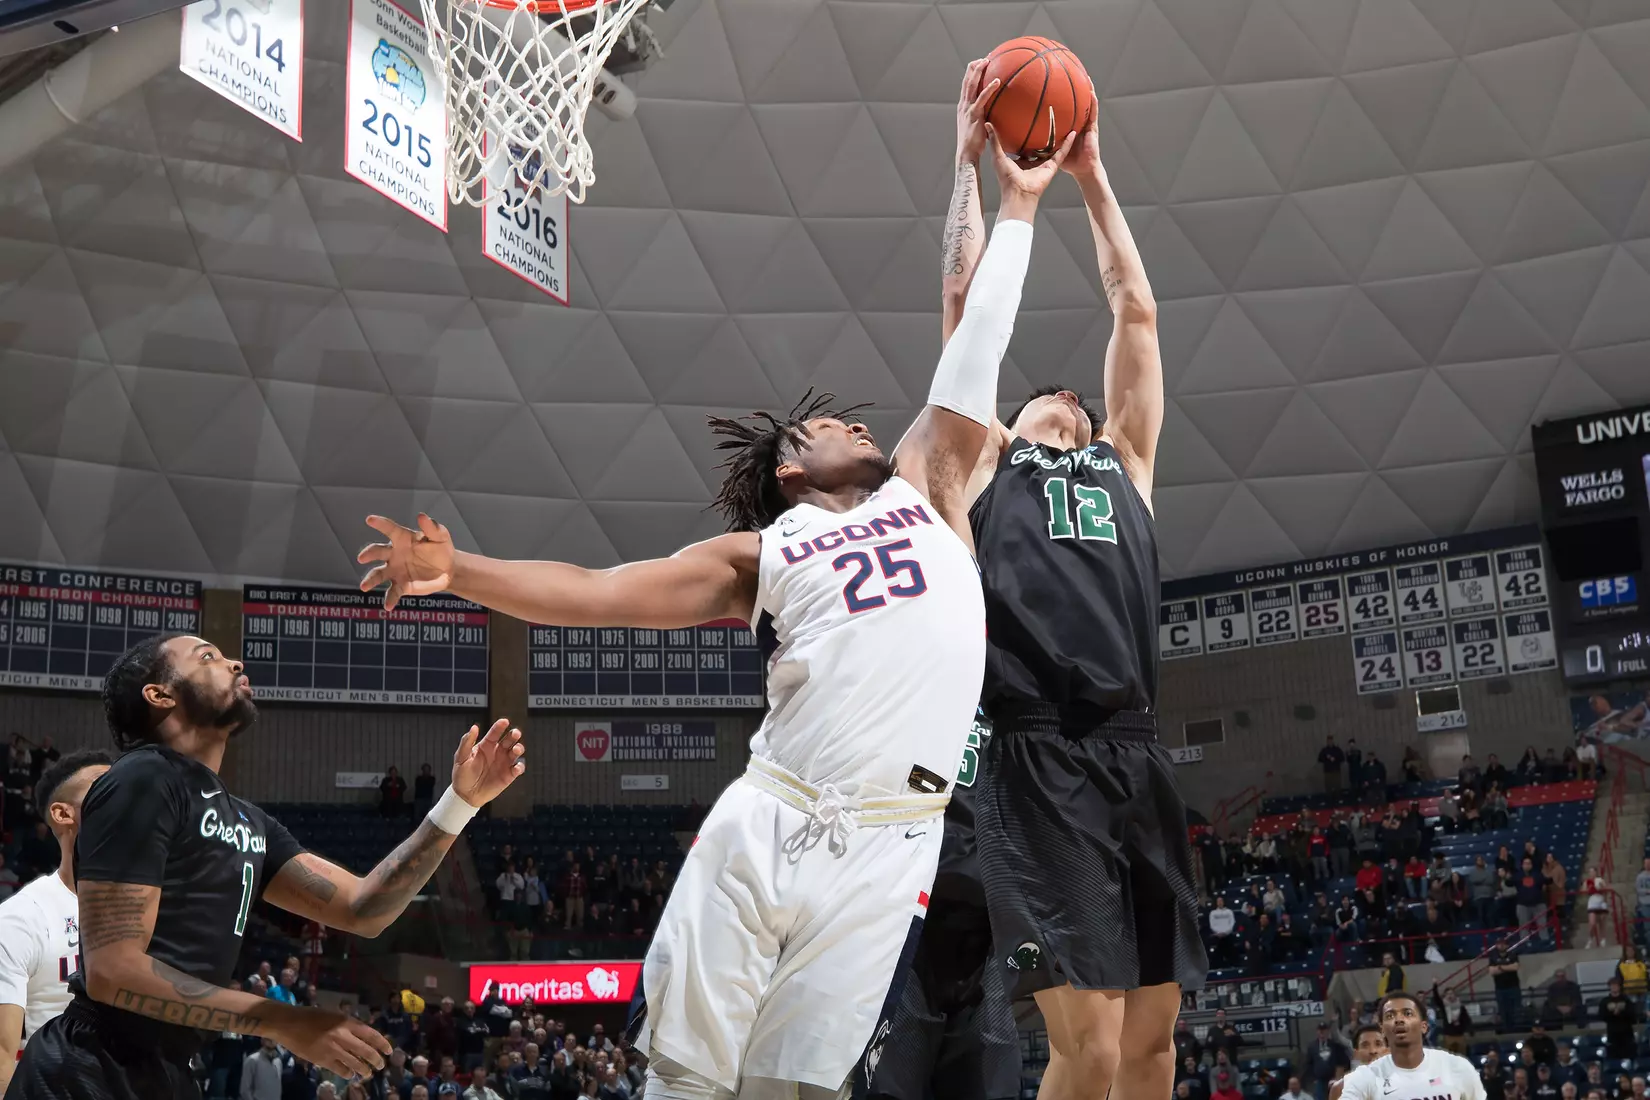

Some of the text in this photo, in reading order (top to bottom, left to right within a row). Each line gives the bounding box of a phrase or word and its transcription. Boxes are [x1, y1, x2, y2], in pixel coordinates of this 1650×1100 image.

[202, 0, 286, 73] 2014
[376, 14, 426, 57] Basketball
[205, 38, 282, 97] NATIONAL
[199, 58, 287, 124] CHAMPIONS
[362, 98, 432, 169] 2015
[365, 140, 431, 192] NATIONAL
[359, 160, 435, 217] CHAMPIONS
[497, 189, 558, 249] 2016
[499, 224, 555, 271] NATIONAL
[495, 242, 560, 293] CHAMPIONS
[1561, 468, 1624, 491] WELLS
[1565, 484, 1625, 507] FARGO
[1043, 477, 1118, 545] 12
[780, 504, 934, 566] UCONN
[1235, 541, 1449, 584] UCONN HUSKIES OF HONOR
[0, 567, 196, 597] AST CONFERENCE
[831, 537, 928, 615] 25
[1504, 572, 1542, 597] 42
[1578, 576, 1631, 600] CBS
[28, 586, 93, 600] SEASON
[101, 592, 195, 609] CHAMPIONS
[250, 590, 267, 600] BIG
[269, 591, 297, 602] EAST
[300, 592, 309, 602] &
[312, 592, 365, 605] AMERICAN
[419, 598, 483, 611] CONFERENCE
[1354, 595, 1390, 619] 42
[1403, 587, 1439, 612] 44
[19, 600, 47, 619] 1995
[57, 603, 85, 621] 1996
[95, 606, 123, 626] 1998
[132, 610, 159, 629] 1999
[168, 611, 196, 631] 2002
[268, 604, 466, 624] TOURNAMENT CHAMPIONS
[1257, 609, 1292, 635] 22
[1304, 602, 1339, 628] 25
[15, 625, 46, 644] 2006
[249, 617, 483, 644] 1990 1996 1998 1999 2002 2004 2011
[533, 629, 558, 645] 1955
[567, 629, 592, 645] 1974
[601, 629, 625, 645] 1975
[634, 630, 658, 646] 1980
[668, 630, 691, 646] 1981
[701, 630, 725, 646] 1982
[1170, 625, 1190, 647] C
[1220, 618, 1233, 640] 9
[247, 642, 273, 659] 2016
[533, 652, 725, 670] 1989 1993 1997 2001 2010 2015
[1413, 650, 1442, 674] 13
[1462, 642, 1496, 668] 22
[1360, 656, 1396, 682] 24
[251, 687, 480, 706] CONNECTICUT MEN'S BASKETBALL
[535, 697, 758, 706] CONNECTICUT MEN'S BASKETBALL
[644, 724, 683, 735] 1988
[1440, 714, 1465, 727] 214
[582, 736, 605, 749] NIT
[612, 736, 716, 748] NATIONAL INVITATION
[612, 748, 716, 760] TOURNAMENT CHAMPION
[1179, 748, 1201, 760] 213
[371, 775, 379, 786] 4
[655, 777, 662, 787] 5
[234, 861, 254, 937] 1
[1234, 1018, 1287, 1032] SEC 113
